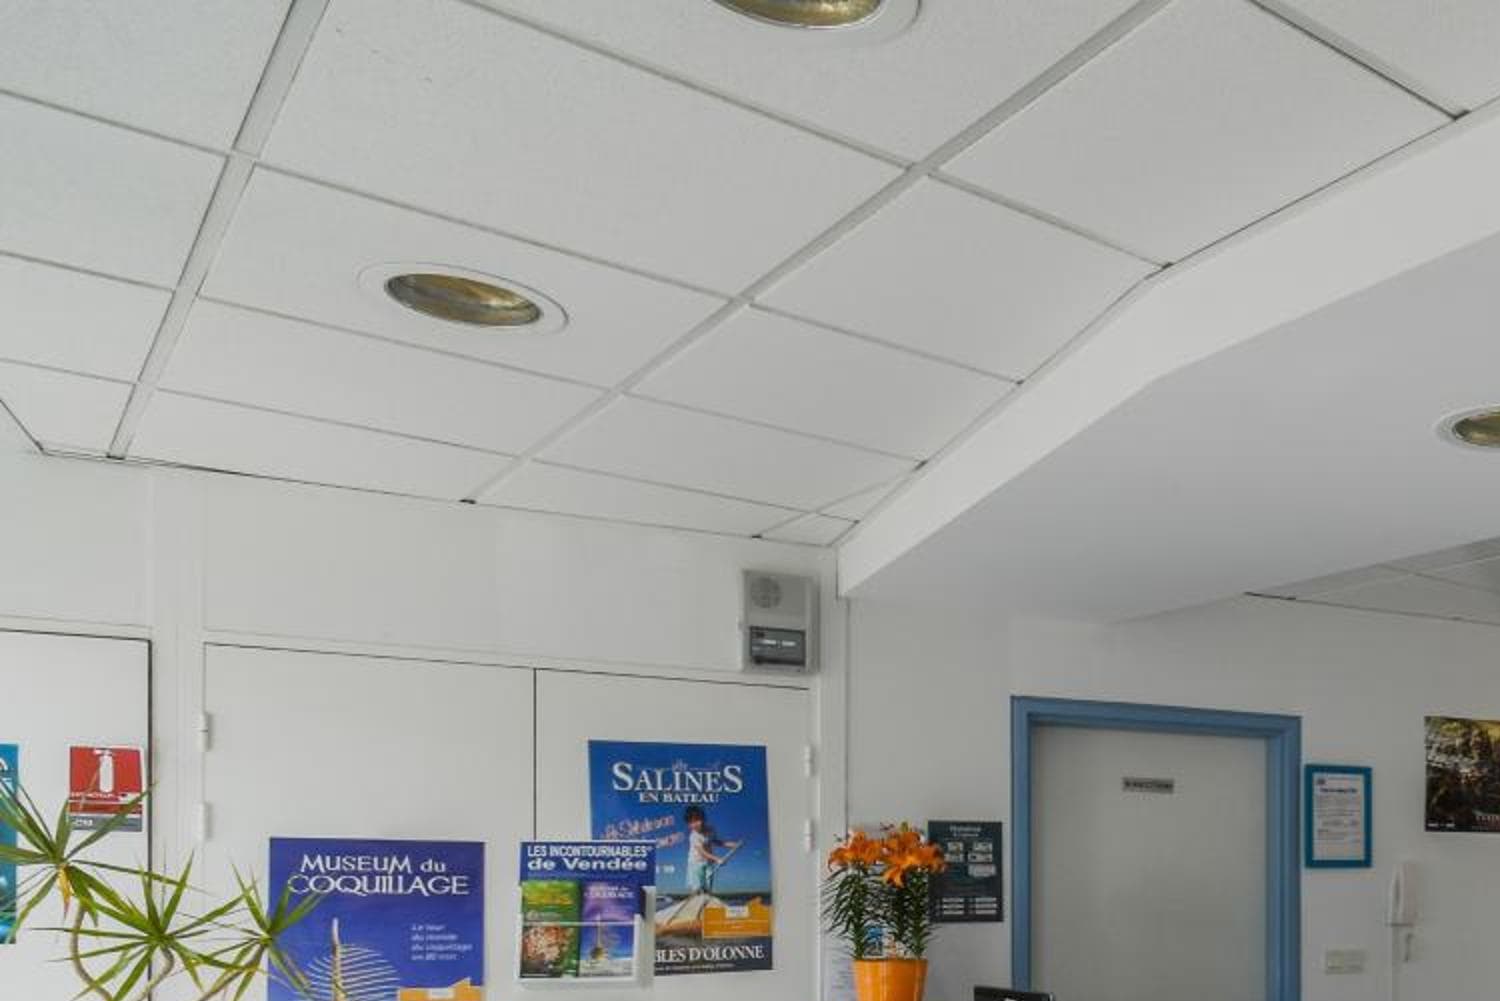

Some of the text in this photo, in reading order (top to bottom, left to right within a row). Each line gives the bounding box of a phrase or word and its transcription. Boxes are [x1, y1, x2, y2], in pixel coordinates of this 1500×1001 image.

[612, 761, 744, 793] SALINES
[639, 792, 720, 803] EN BATEAU
[527, 845, 547, 857] LES
[300, 854, 447, 874] MUSEUM du
[527, 857, 555, 871] de
[562, 857, 648, 871] Vendée
[287, 873, 470, 897] COQUILLAGE
[689, 945, 765, 961] D'OLONNE
